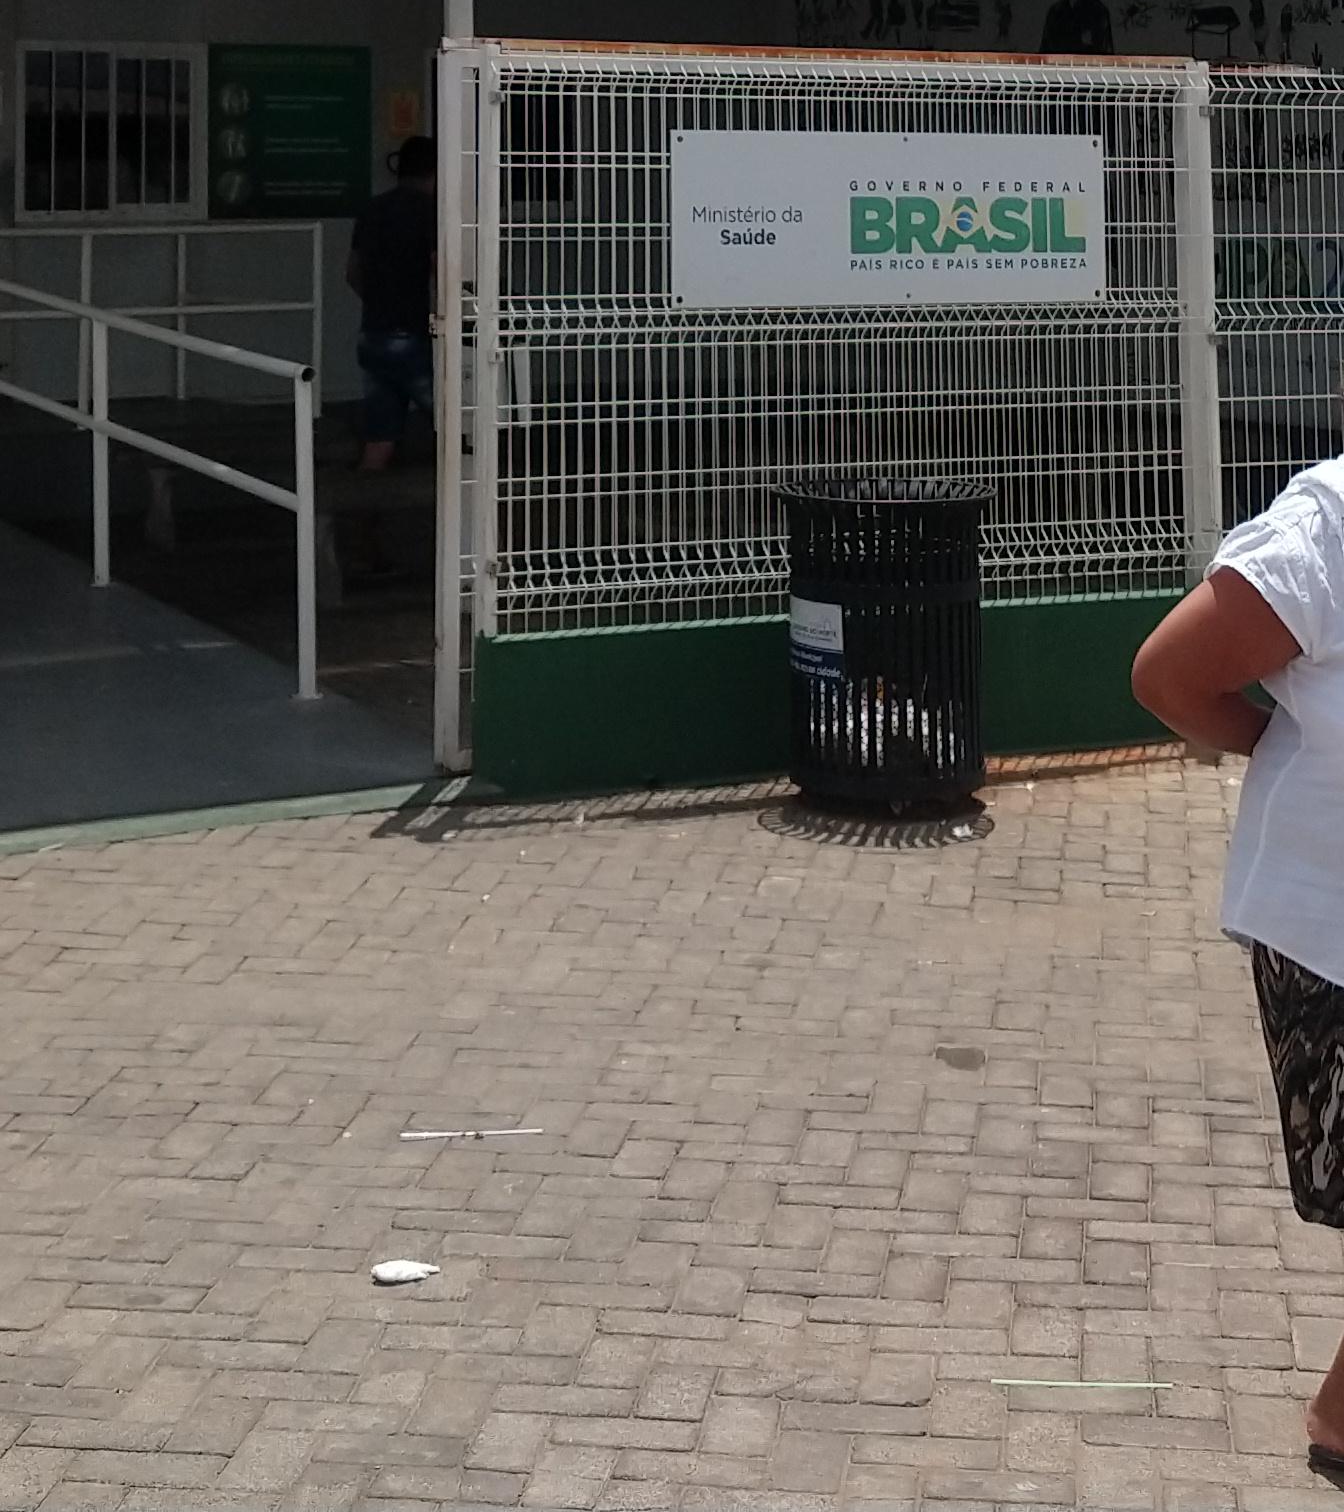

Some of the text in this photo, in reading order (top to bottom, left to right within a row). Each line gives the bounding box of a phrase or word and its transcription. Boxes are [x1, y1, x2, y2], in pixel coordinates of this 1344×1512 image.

[849, 180, 1086, 193] GOVERNO FEDERAL
[692, 205, 803, 223] Ministério da
[850, 196, 1086, 254] BRASIL
[720, 228, 776, 245] Saúde
[850, 257, 882, 271] PAÍS
[890, 259, 925, 270] RICO
[947, 257, 978, 269] PAÍS
[986, 258, 1013, 269] SEM
[1021, 258, 1087, 269] POBREZA
